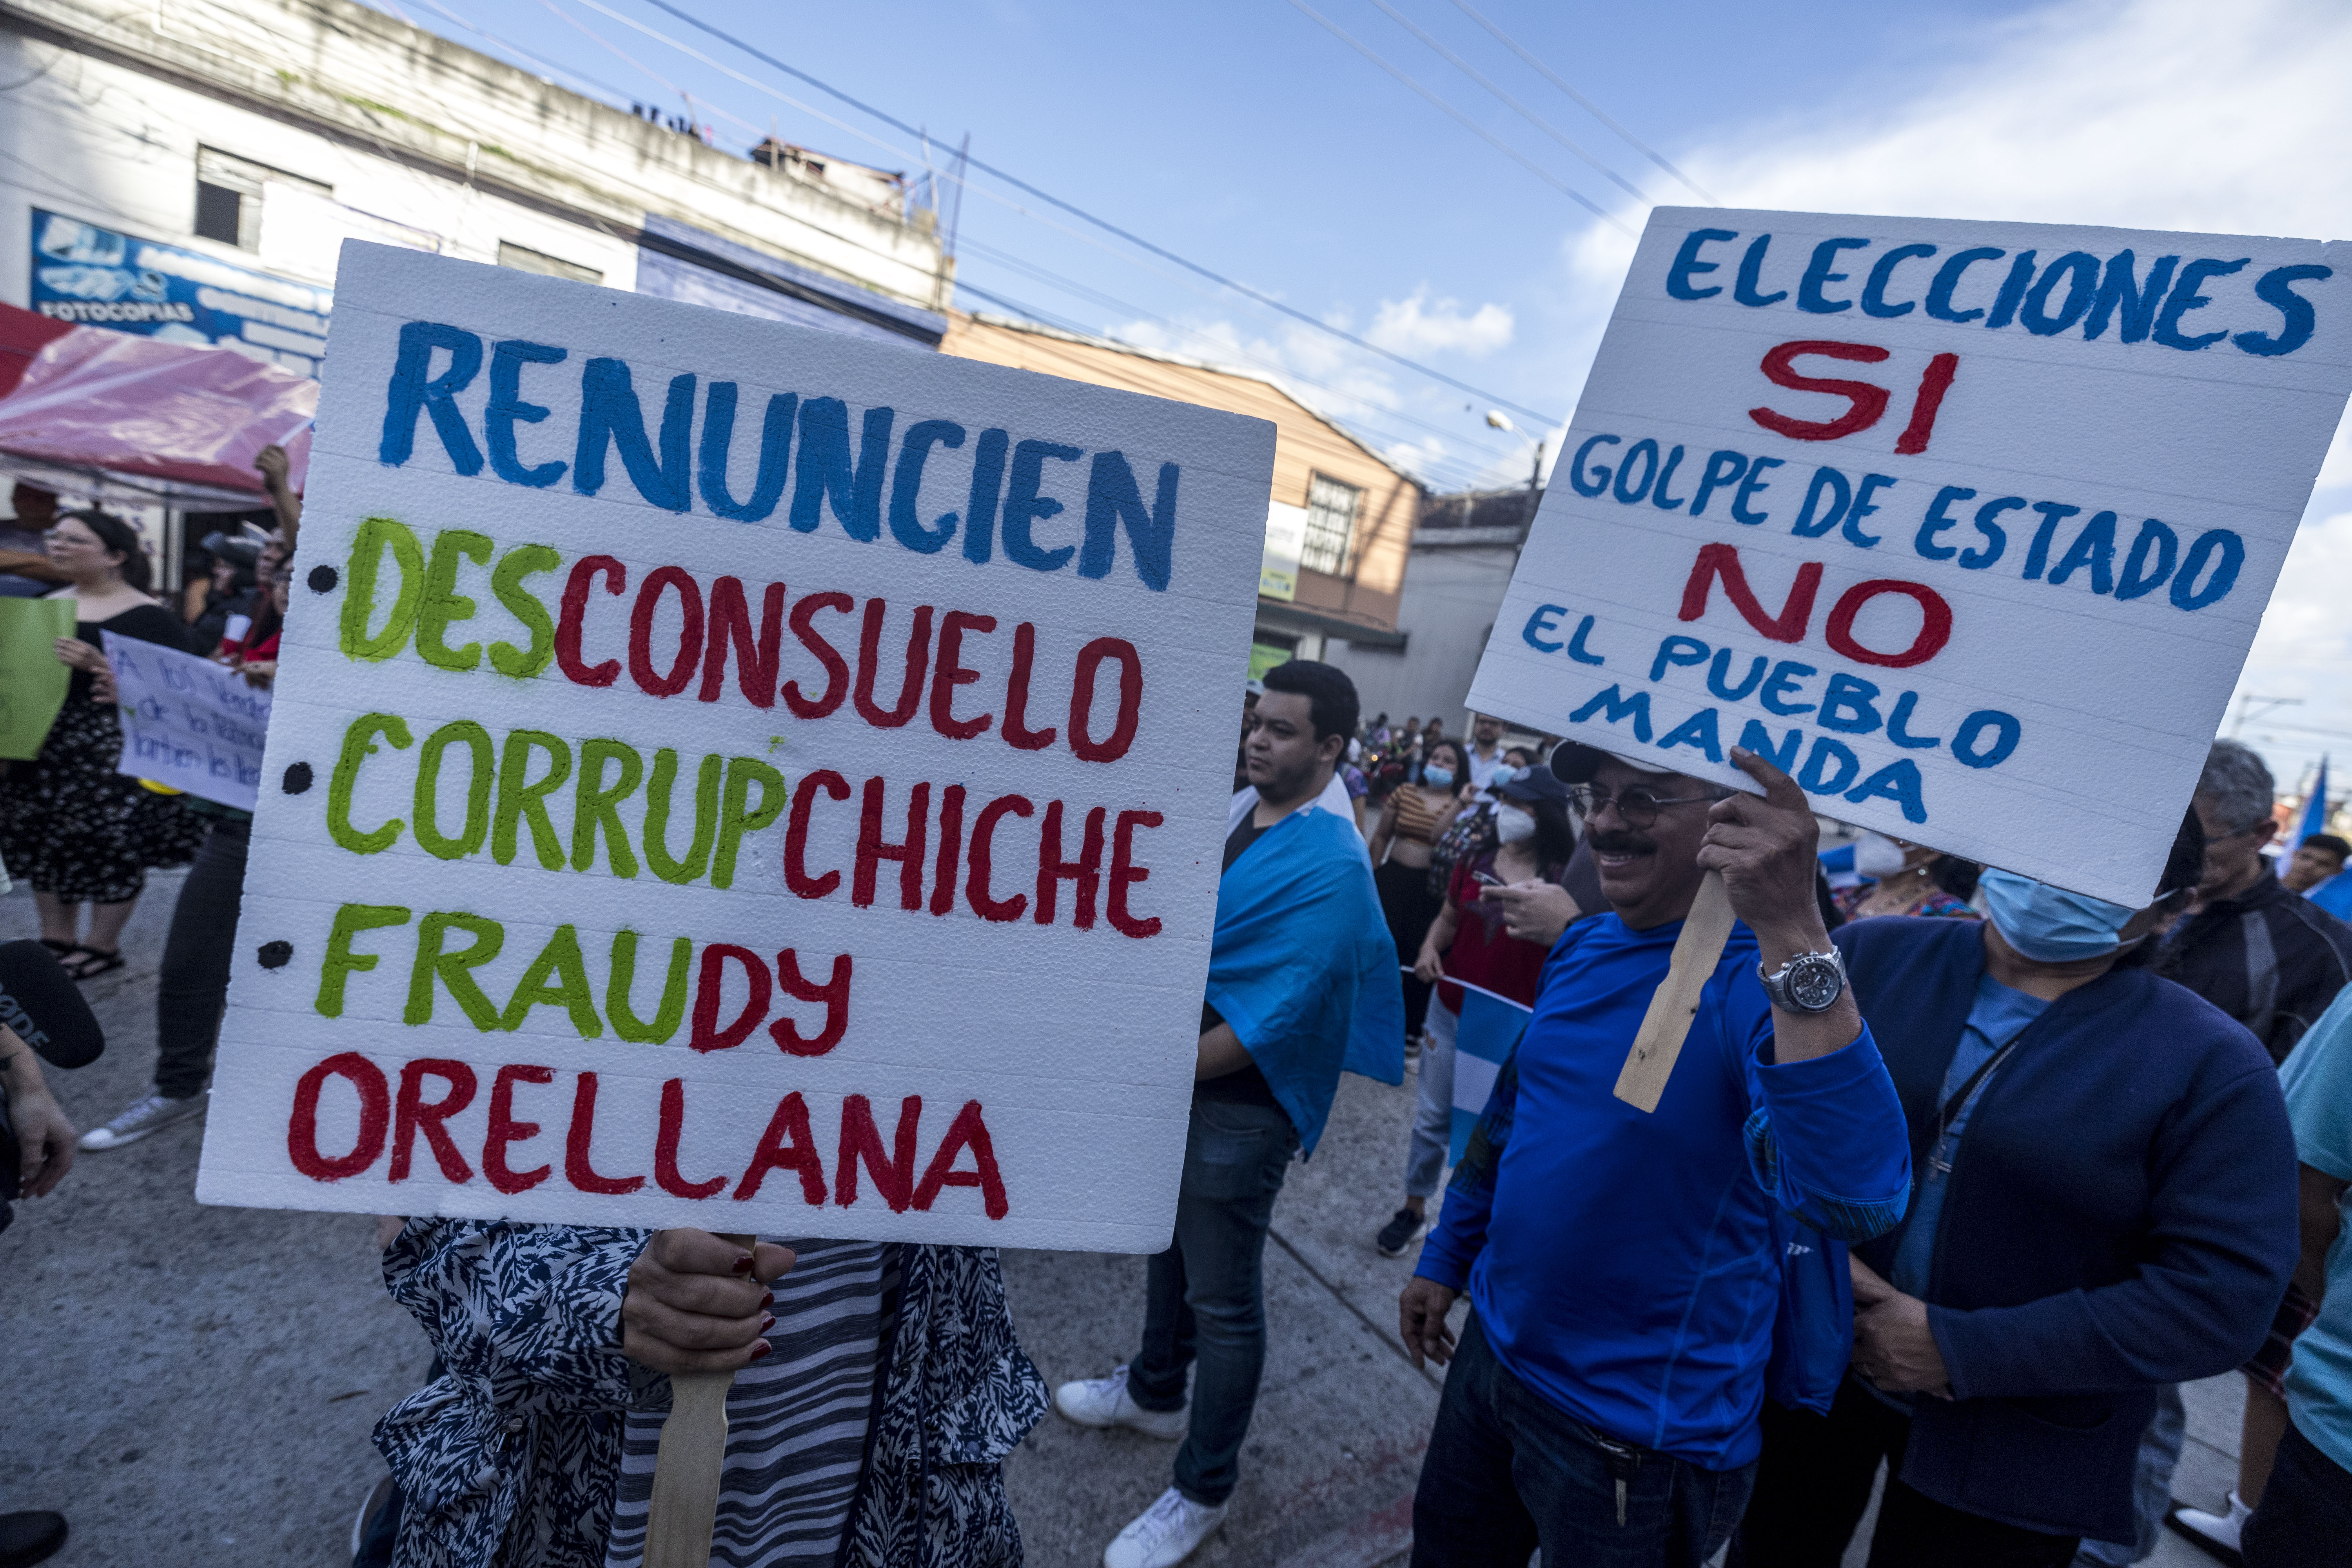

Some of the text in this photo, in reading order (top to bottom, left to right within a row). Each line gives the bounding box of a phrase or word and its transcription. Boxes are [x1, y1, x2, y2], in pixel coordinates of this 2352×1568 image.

[1667, 229, 2333, 357] ELECCIONES
[379, 321, 1179, 591] RENUNCIEN
[1749, 341, 1958, 454] SI
[1571, 434, 2245, 612] GOLPE DE ESTADO
[1679, 544, 1952, 667] NO
[340, 518, 1143, 762] DESCONSUELO
[1523, 604, 2021, 769] EL PUEBLO
[327, 713, 1163, 938] CORRUPCHICHE
[1570, 684, 1927, 824] MANDA
[315, 904, 852, 1056] FRAUDY
[288, 1052, 1008, 1220] ORELLANA
